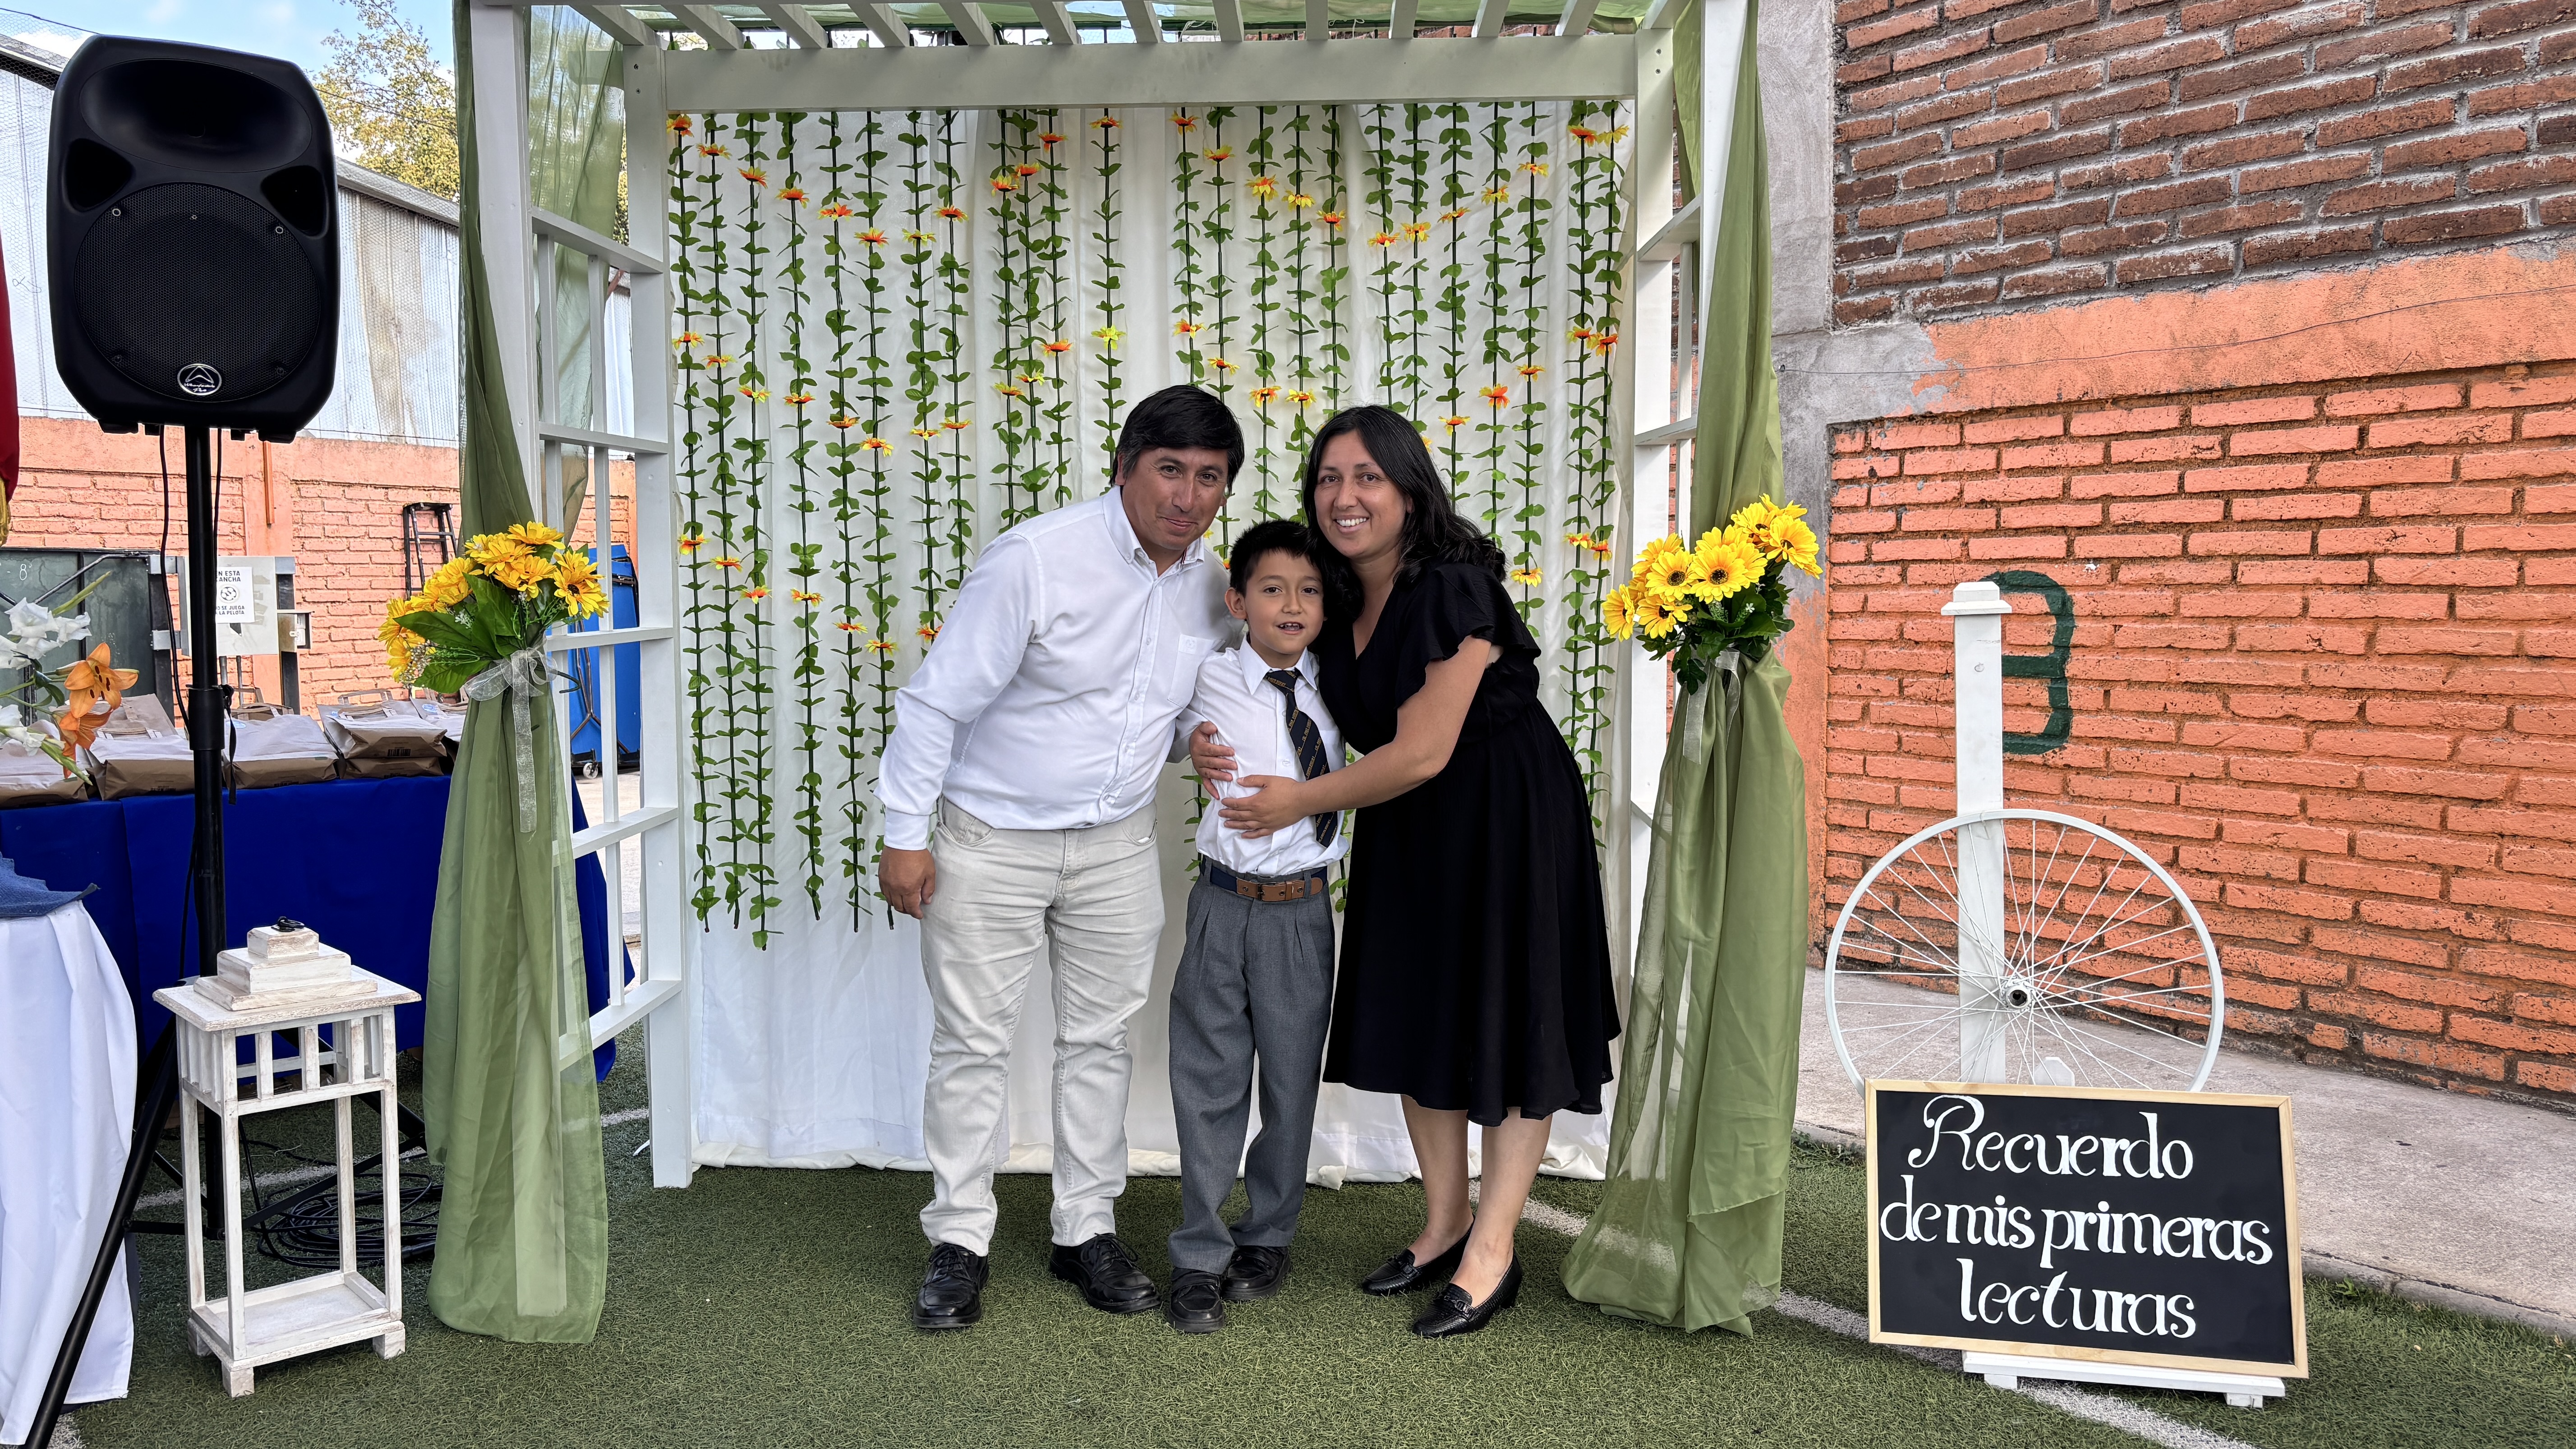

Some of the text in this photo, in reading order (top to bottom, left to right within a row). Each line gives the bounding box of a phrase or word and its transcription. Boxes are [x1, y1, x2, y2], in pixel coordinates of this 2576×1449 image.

[1908, 1095, 2194, 1179] Recuerdo
[2040, 1201, 2273, 1269] primeras
[1956, 1258, 2197, 1339] lecturas
